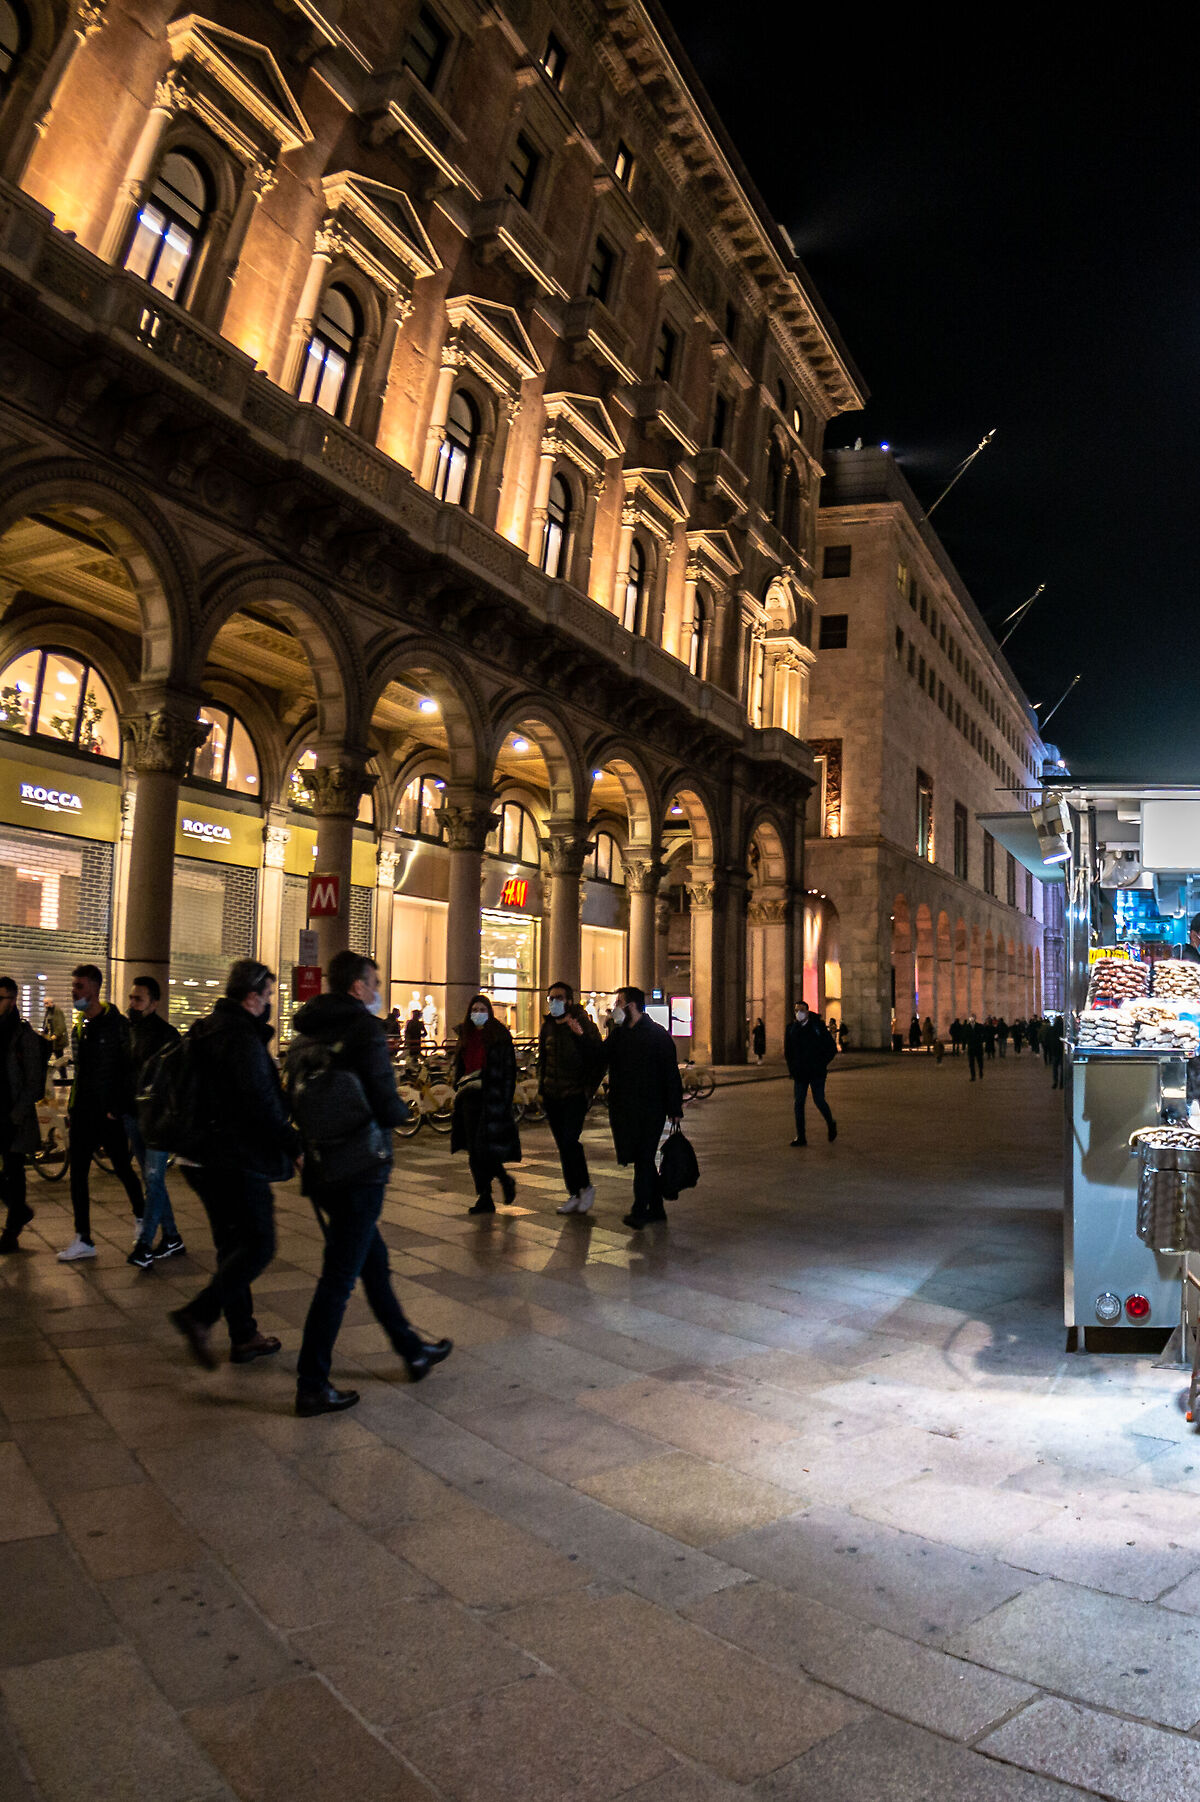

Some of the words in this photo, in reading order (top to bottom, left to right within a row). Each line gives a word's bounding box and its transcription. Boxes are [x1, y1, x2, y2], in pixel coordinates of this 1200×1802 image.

[21, 783, 83, 809] ROCCA
[182, 819, 232, 840] ROCCA
[311, 883, 337, 909] M
